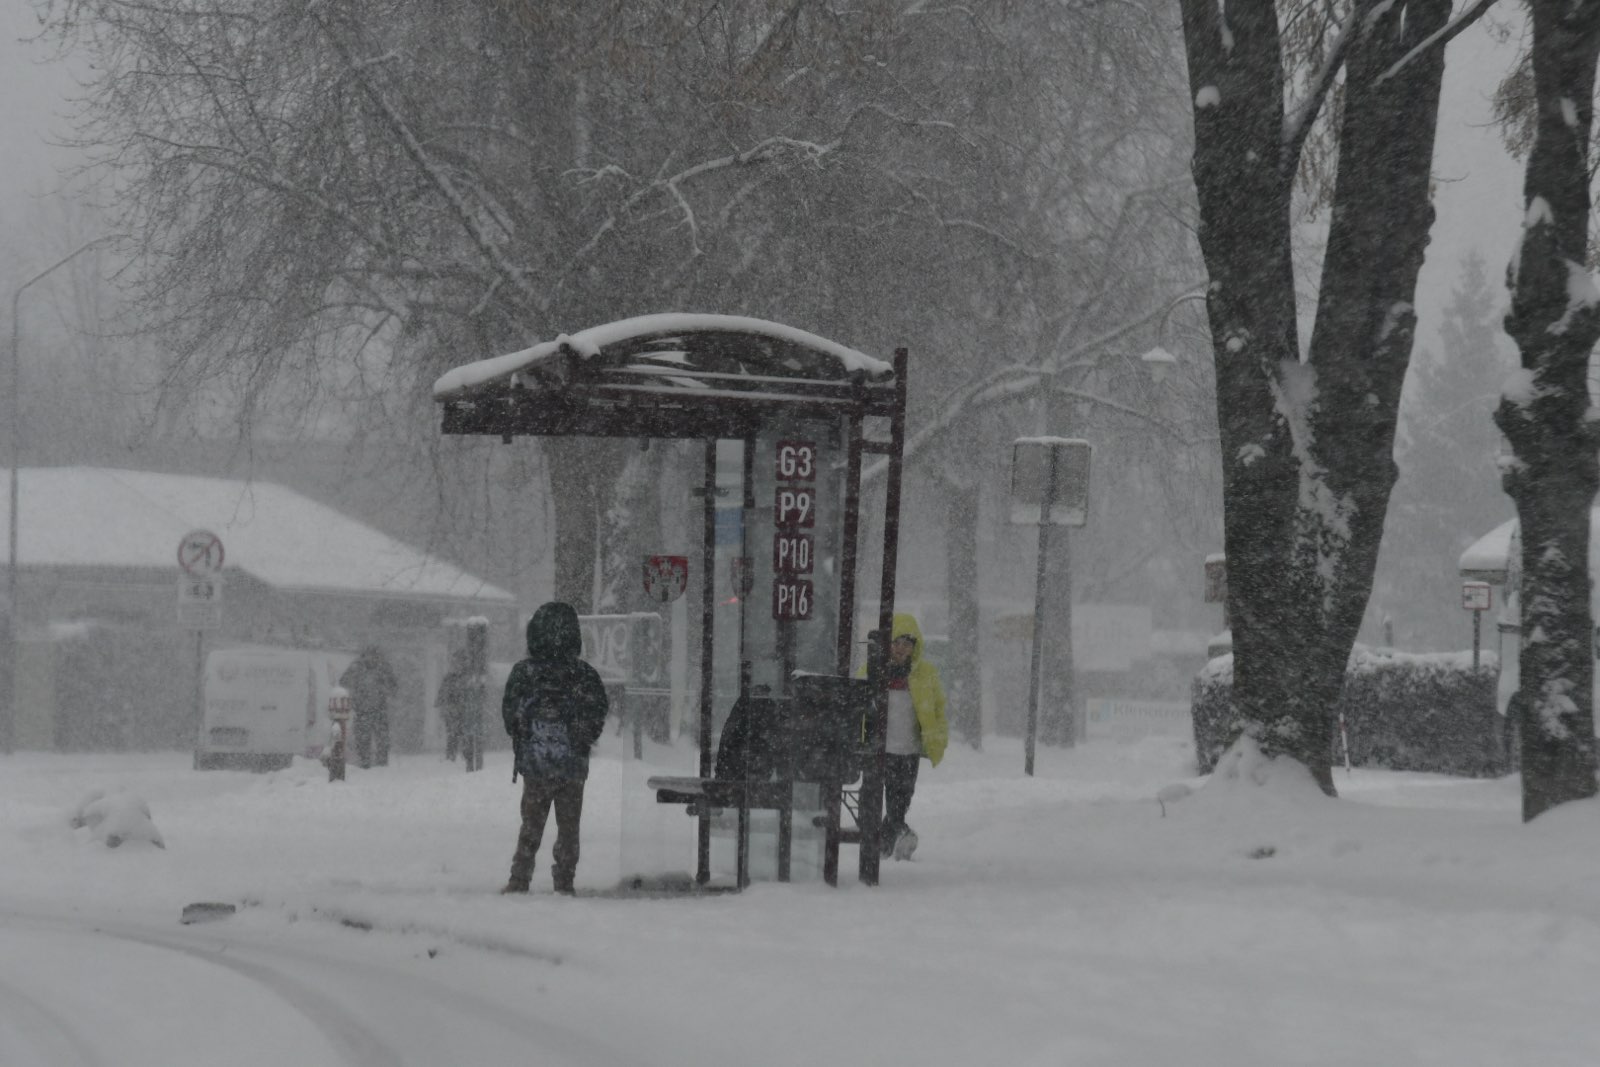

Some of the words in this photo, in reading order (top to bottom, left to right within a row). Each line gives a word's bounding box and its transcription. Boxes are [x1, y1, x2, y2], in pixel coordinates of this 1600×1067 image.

[780, 447, 812, 477] G3
[779, 492, 810, 522] P9
[779, 538, 808, 569] P10
[778, 584, 808, 615] P16
